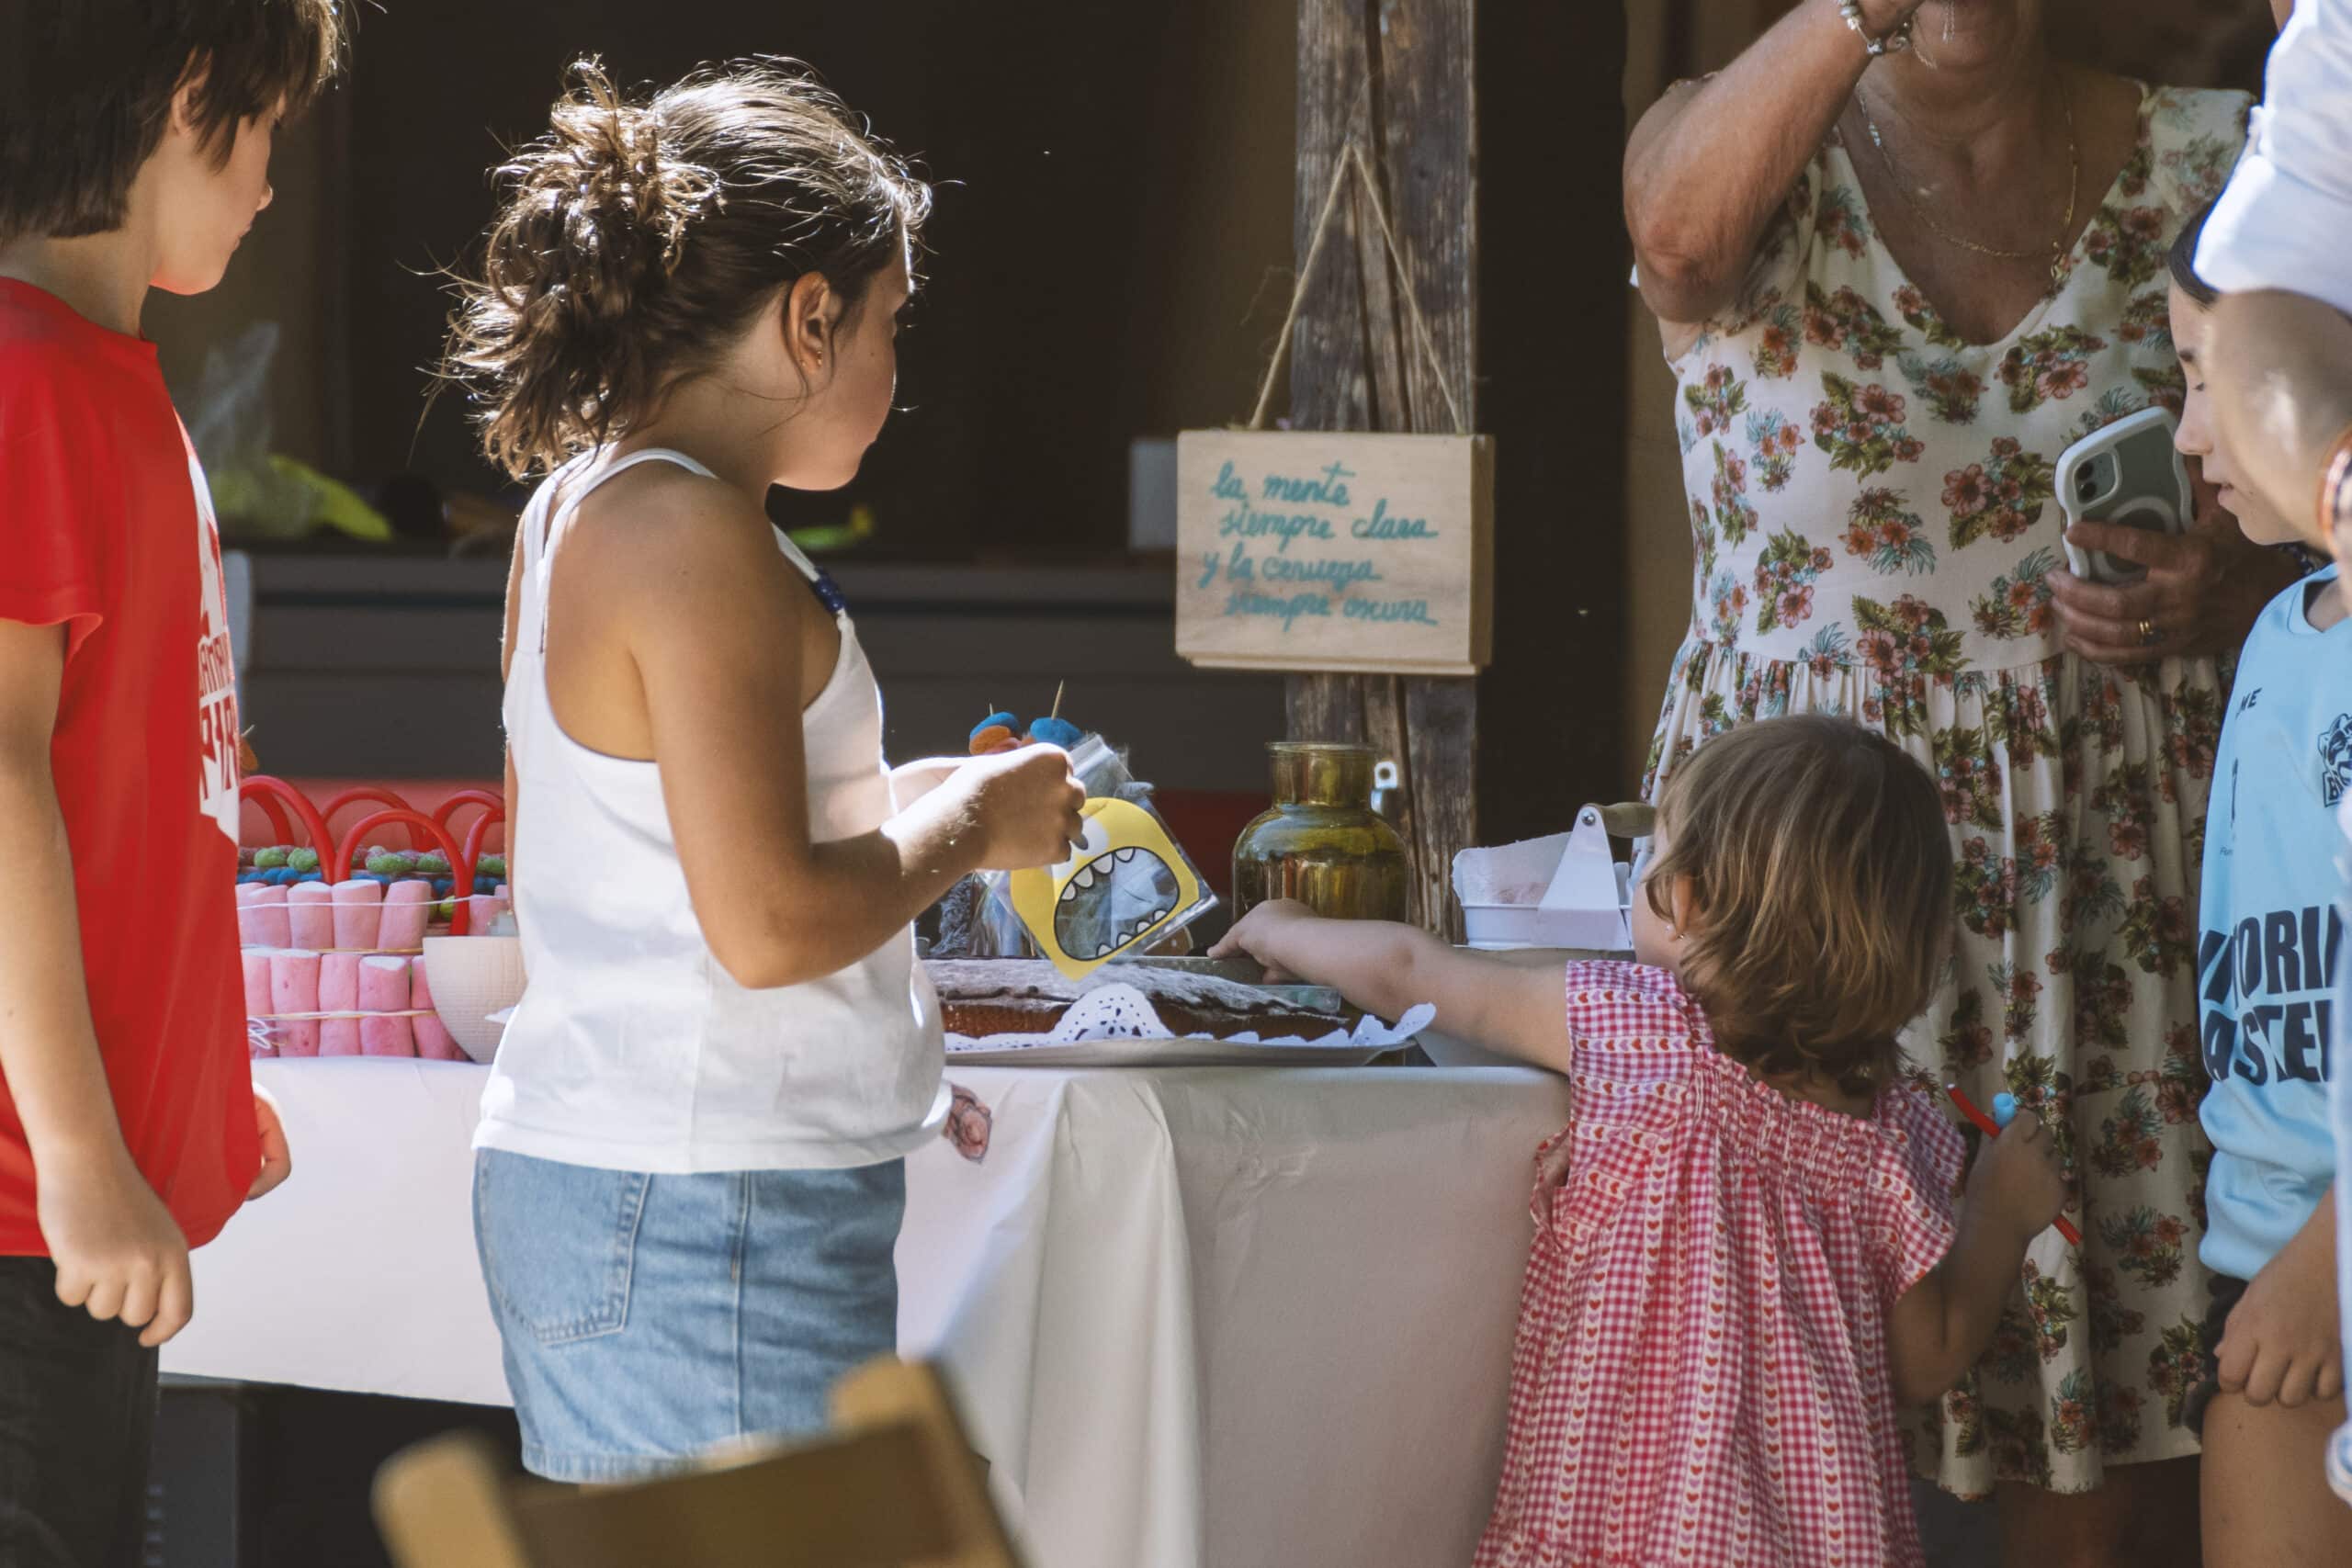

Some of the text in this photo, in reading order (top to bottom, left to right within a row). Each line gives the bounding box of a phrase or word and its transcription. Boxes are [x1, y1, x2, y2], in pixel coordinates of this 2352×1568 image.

[1210, 460, 1356, 506] la mente
[1219, 499, 1439, 553] siempre clara
[1198, 552, 1220, 589] y
[1226, 541, 1255, 582] la
[1224, 592, 1440, 632] siempre oscura
